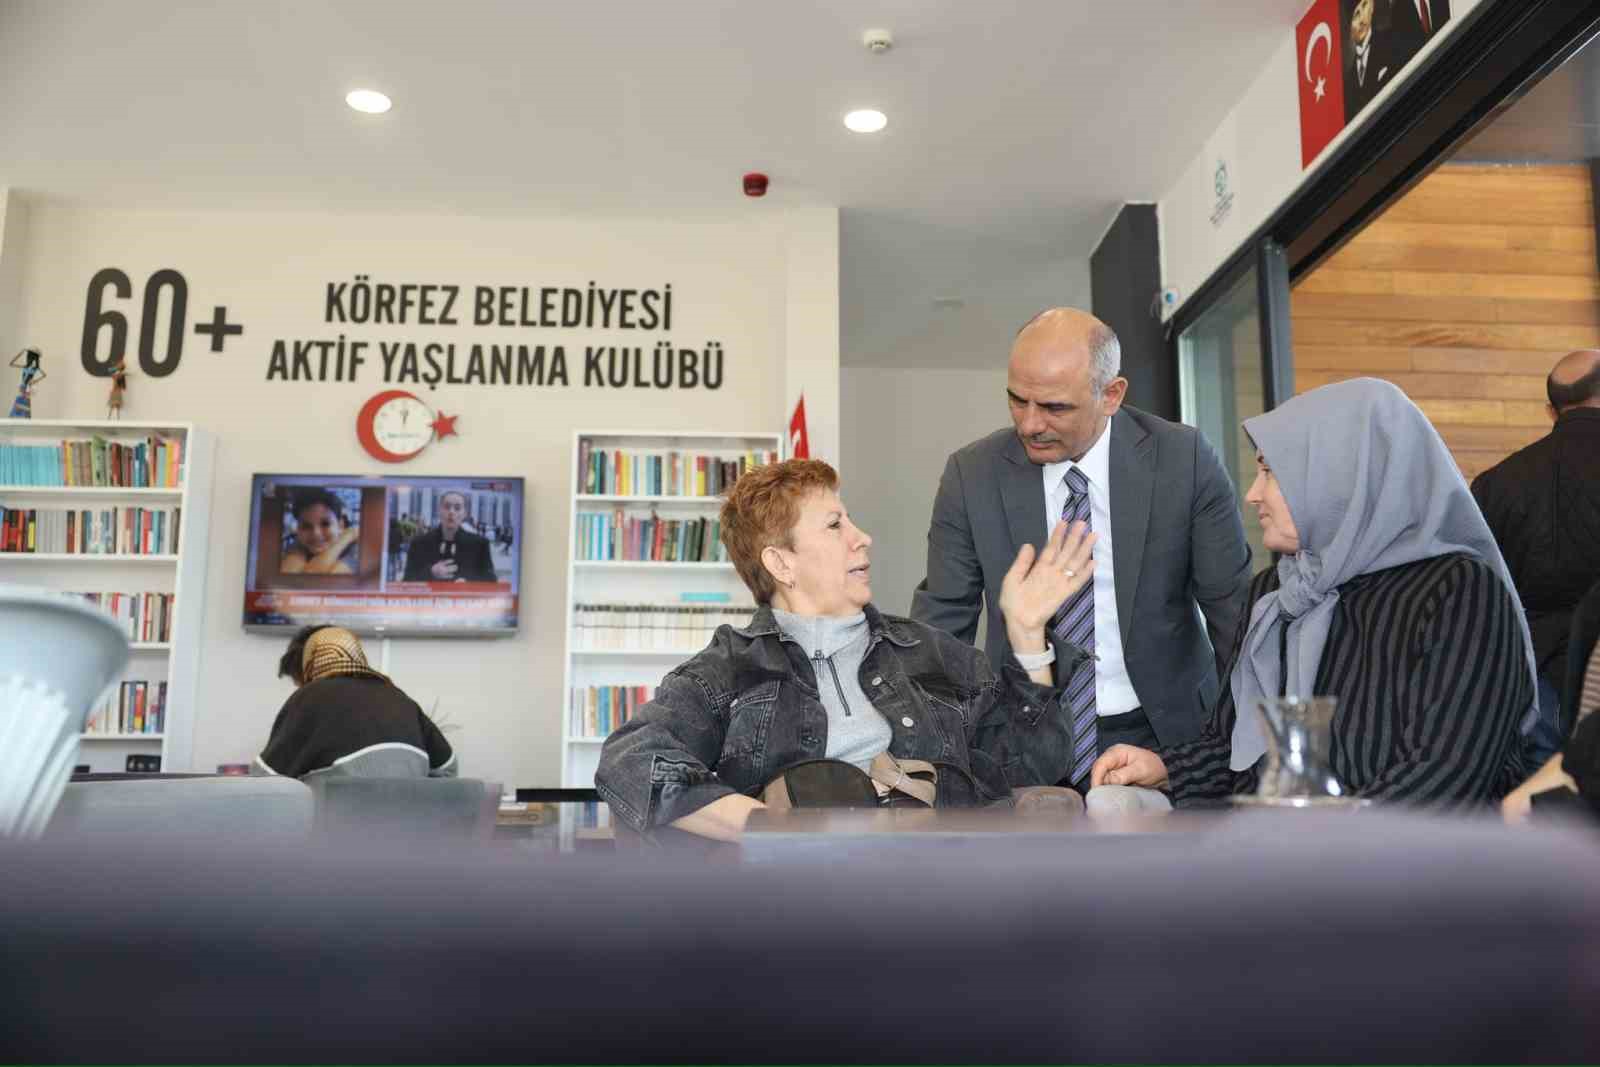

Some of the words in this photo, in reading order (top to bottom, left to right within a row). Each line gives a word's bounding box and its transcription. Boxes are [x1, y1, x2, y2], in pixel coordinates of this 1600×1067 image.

[80, 267, 244, 379] 60+
[325, 274, 460, 325] KÖRFEZ
[473, 280, 673, 331] BELEDİYESİ
[266, 334, 369, 382] AKTİF
[379, 341, 569, 391] YAŞLANMA
[583, 341, 724, 390] KULÜBÜ
